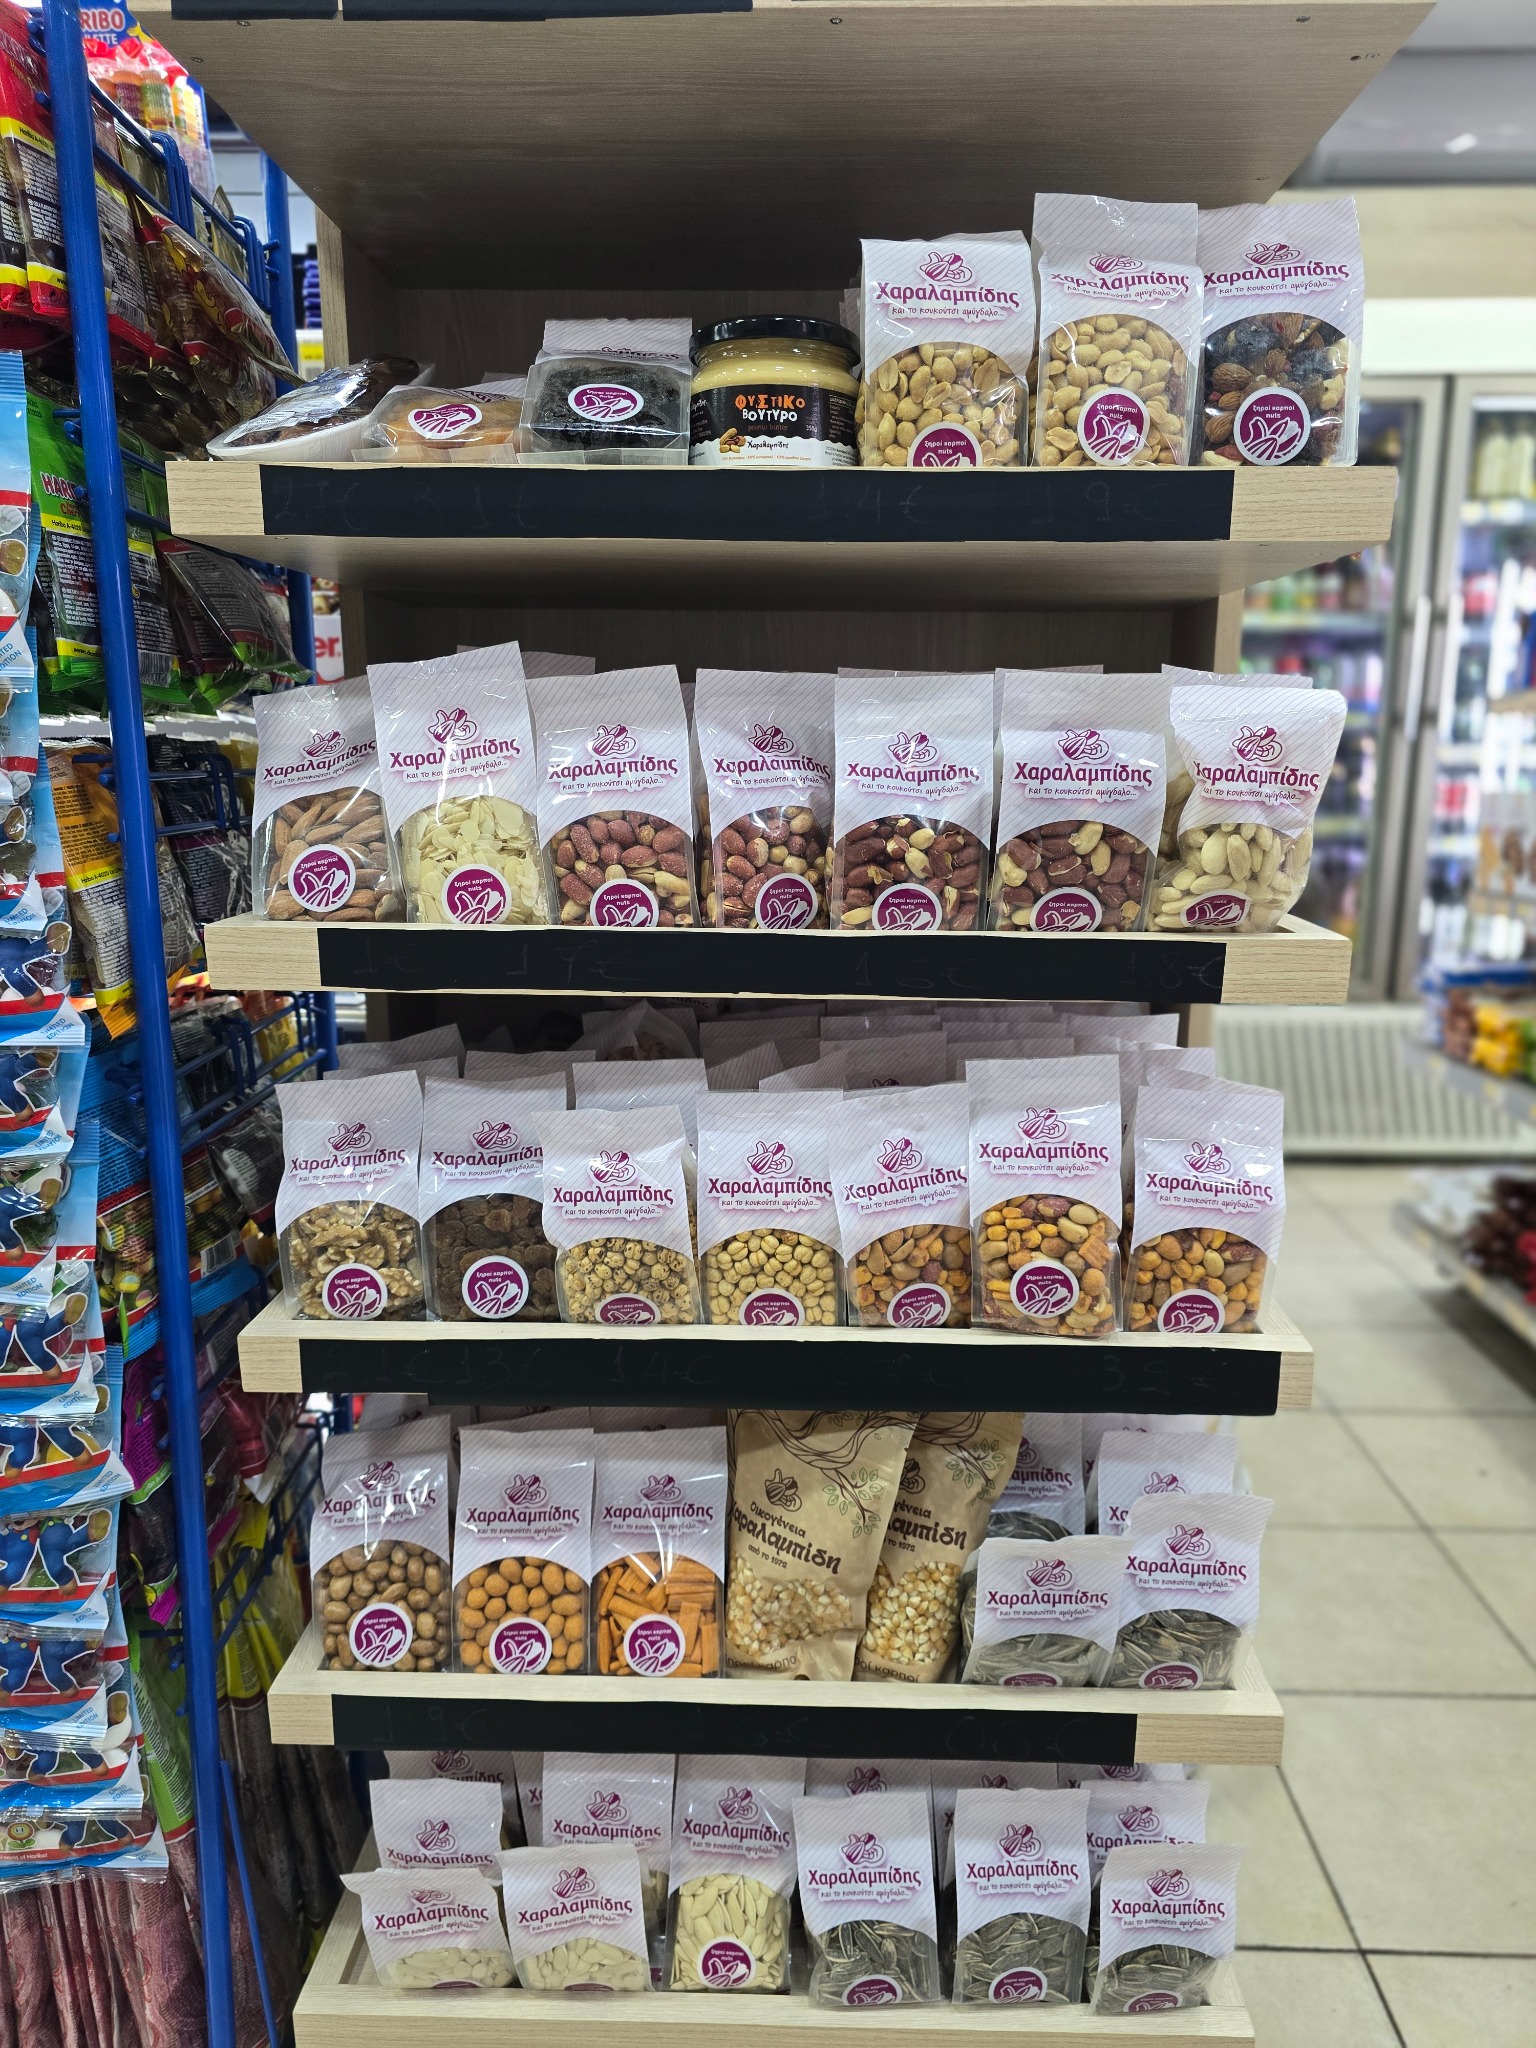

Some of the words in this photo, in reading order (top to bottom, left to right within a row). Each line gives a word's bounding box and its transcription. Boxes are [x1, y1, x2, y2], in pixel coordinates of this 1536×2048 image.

[80, 8, 125, 31] RIBO
[1051, 271, 1189, 293] Χαραλαμπίδης
[1204, 261, 1350, 288] Χαραλαμπίδης
[876, 282, 1020, 308] Χαραλαμπίδης
[263, 740, 377, 780] Χαραλαμπίδης
[847, 762, 980, 786] Χαραλαμπίδης
[1014, 762, 1153, 786] Χαραλαμπίδης
[290, 1149, 406, 1173] Χαραλαμπίδης
[432, 1146, 543, 1168] Χαραλαμπίδη
[979, 1141, 1109, 1162] Χαραλαμπίδης
[553, 1184, 674, 1205] Χαραλαμπίδης
[708, 1176, 832, 1197] Χαραλαμπίδης
[845, 1167, 968, 1201] Χαραλαμπίδης
[467, 1506, 580, 1525] Χαραλαμπίδης
[603, 1503, 714, 1522] Χαραλαμπίδης
[1126, 1556, 1247, 1580] Χαραλαμπίδης
[987, 1589, 1109, 1609] Χαραλαμπίδης
[554, 1819, 661, 1839] Χαραλαμπίδης
[683, 1819, 790, 1846] Χαραλαμπίδης
[809, 1869, 922, 1891] Χαραλαμπίδης
[967, 1859, 1079, 1881] Χαραλαμπίδης
[374, 1904, 489, 1930] Χαραλαμπίδης
[519, 1894, 633, 1924] Χαραλαμπίδης
[1112, 1898, 1225, 1918] Χαραλαμπίδης
